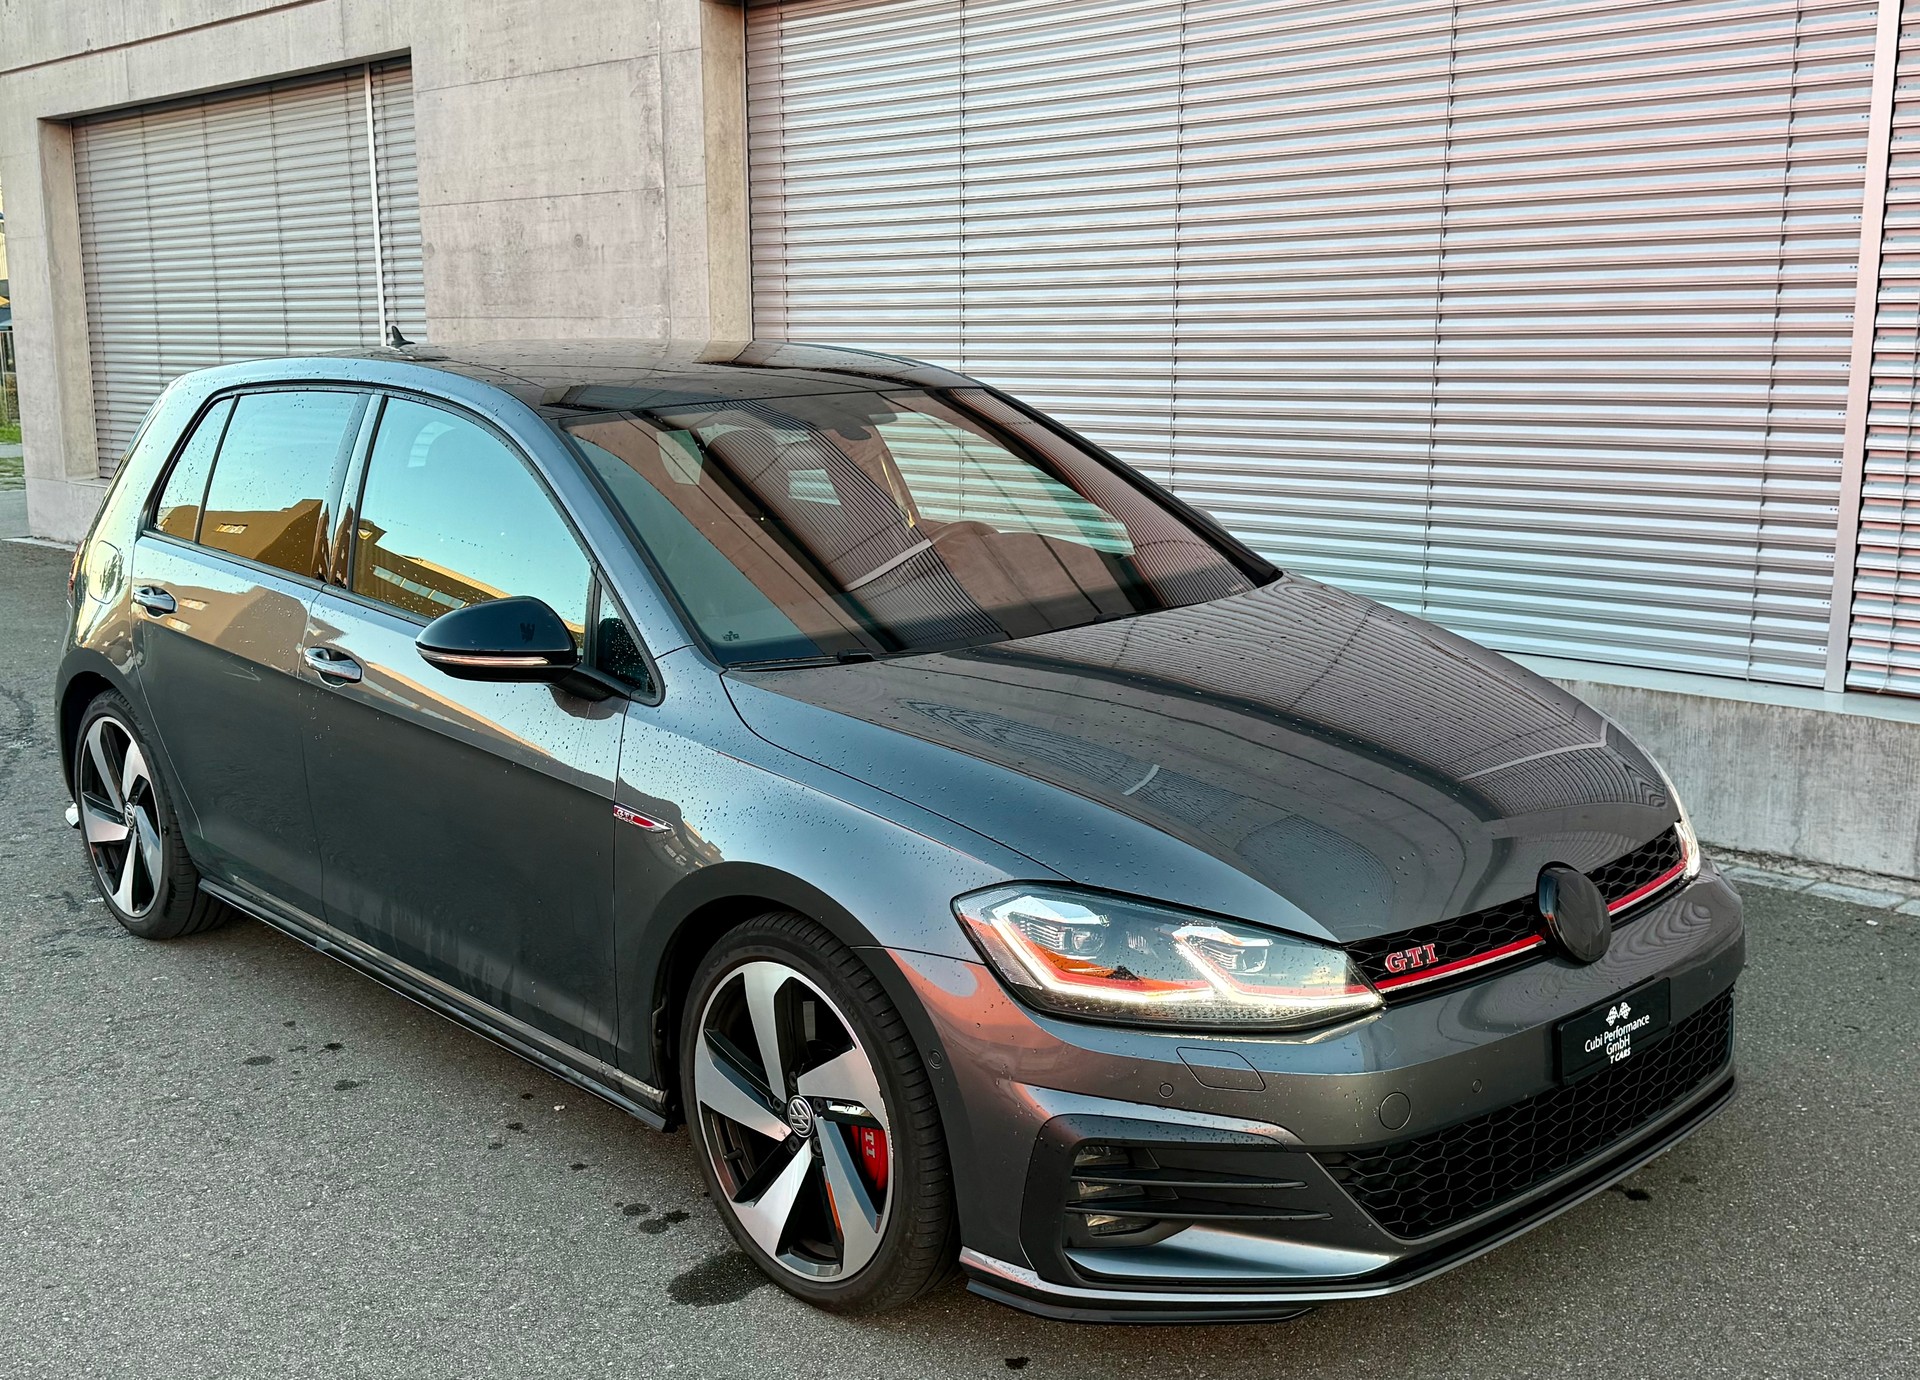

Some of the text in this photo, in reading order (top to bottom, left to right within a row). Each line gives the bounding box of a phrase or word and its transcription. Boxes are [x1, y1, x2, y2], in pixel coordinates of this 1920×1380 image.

[1384, 943, 1439, 973] GTI
[1584, 1014, 1650, 1053] Cubi Performance
[1606, 1033, 1631, 1055] GmbH
[1614, 1047, 1631, 1062] CARS
[864, 1127, 876, 1159] TI
